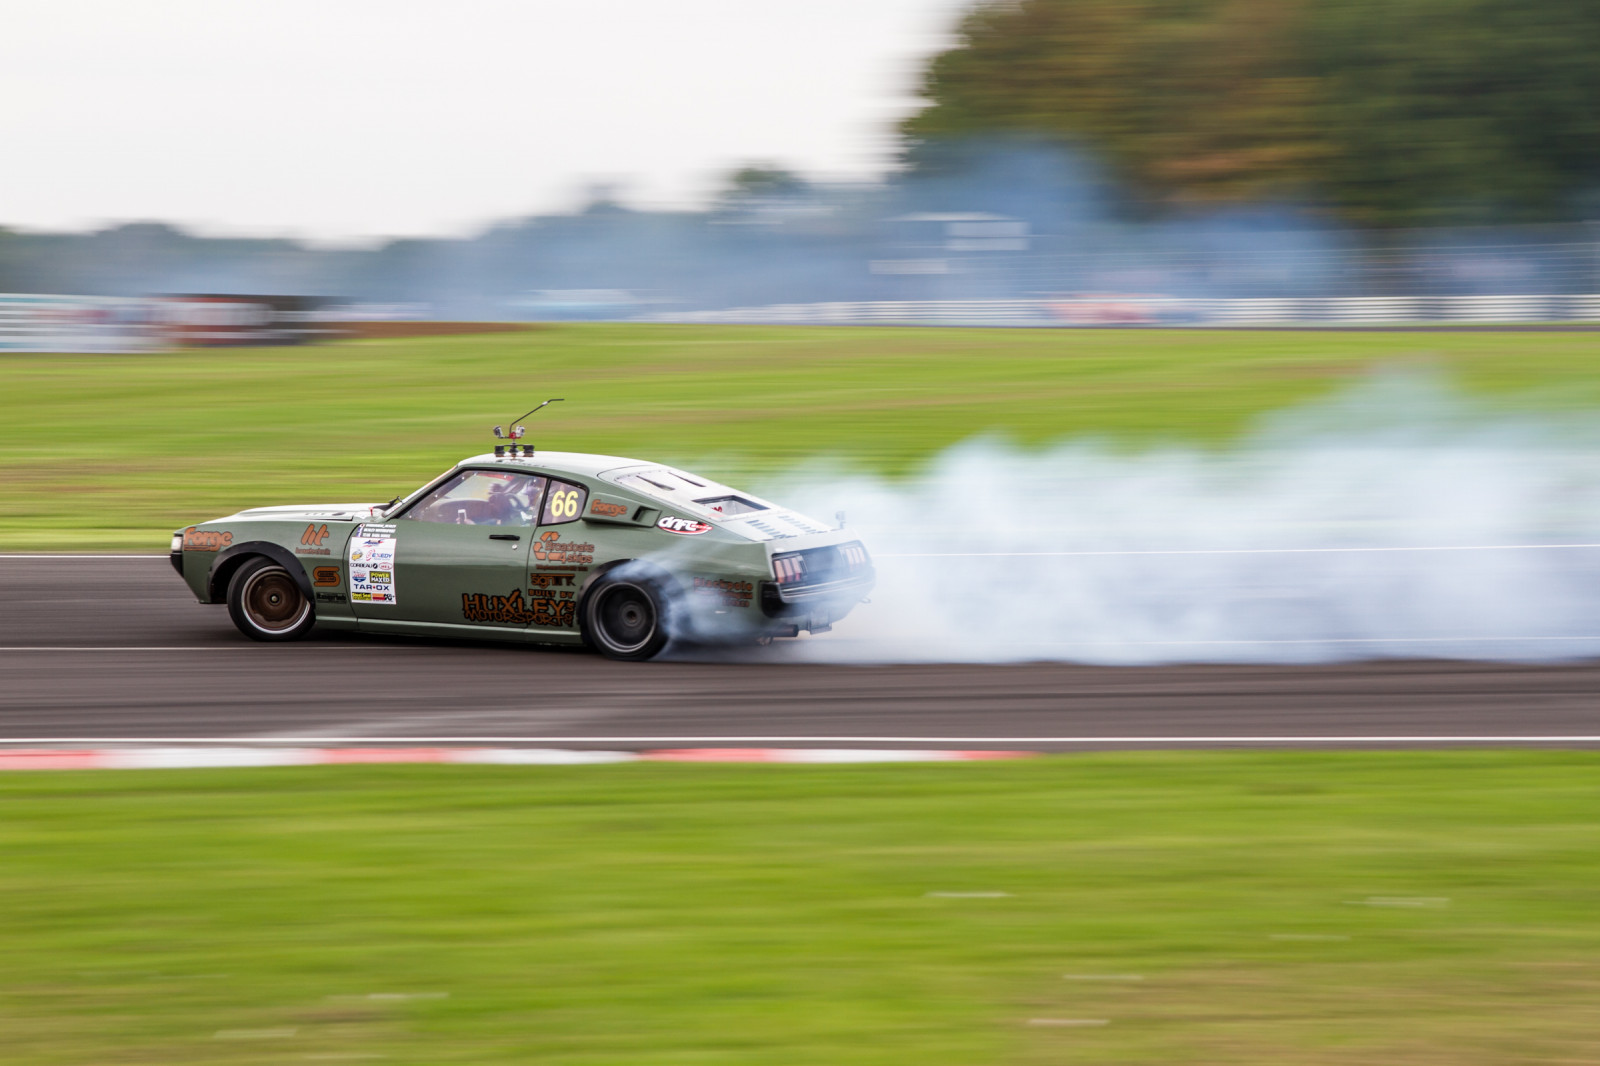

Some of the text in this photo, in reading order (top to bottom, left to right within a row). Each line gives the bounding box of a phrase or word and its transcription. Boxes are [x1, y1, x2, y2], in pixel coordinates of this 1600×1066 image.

[551, 490, 578, 517] 66
[461, 588, 566, 617] HUXLEY
[528, 589, 575, 599] BUILT BY
